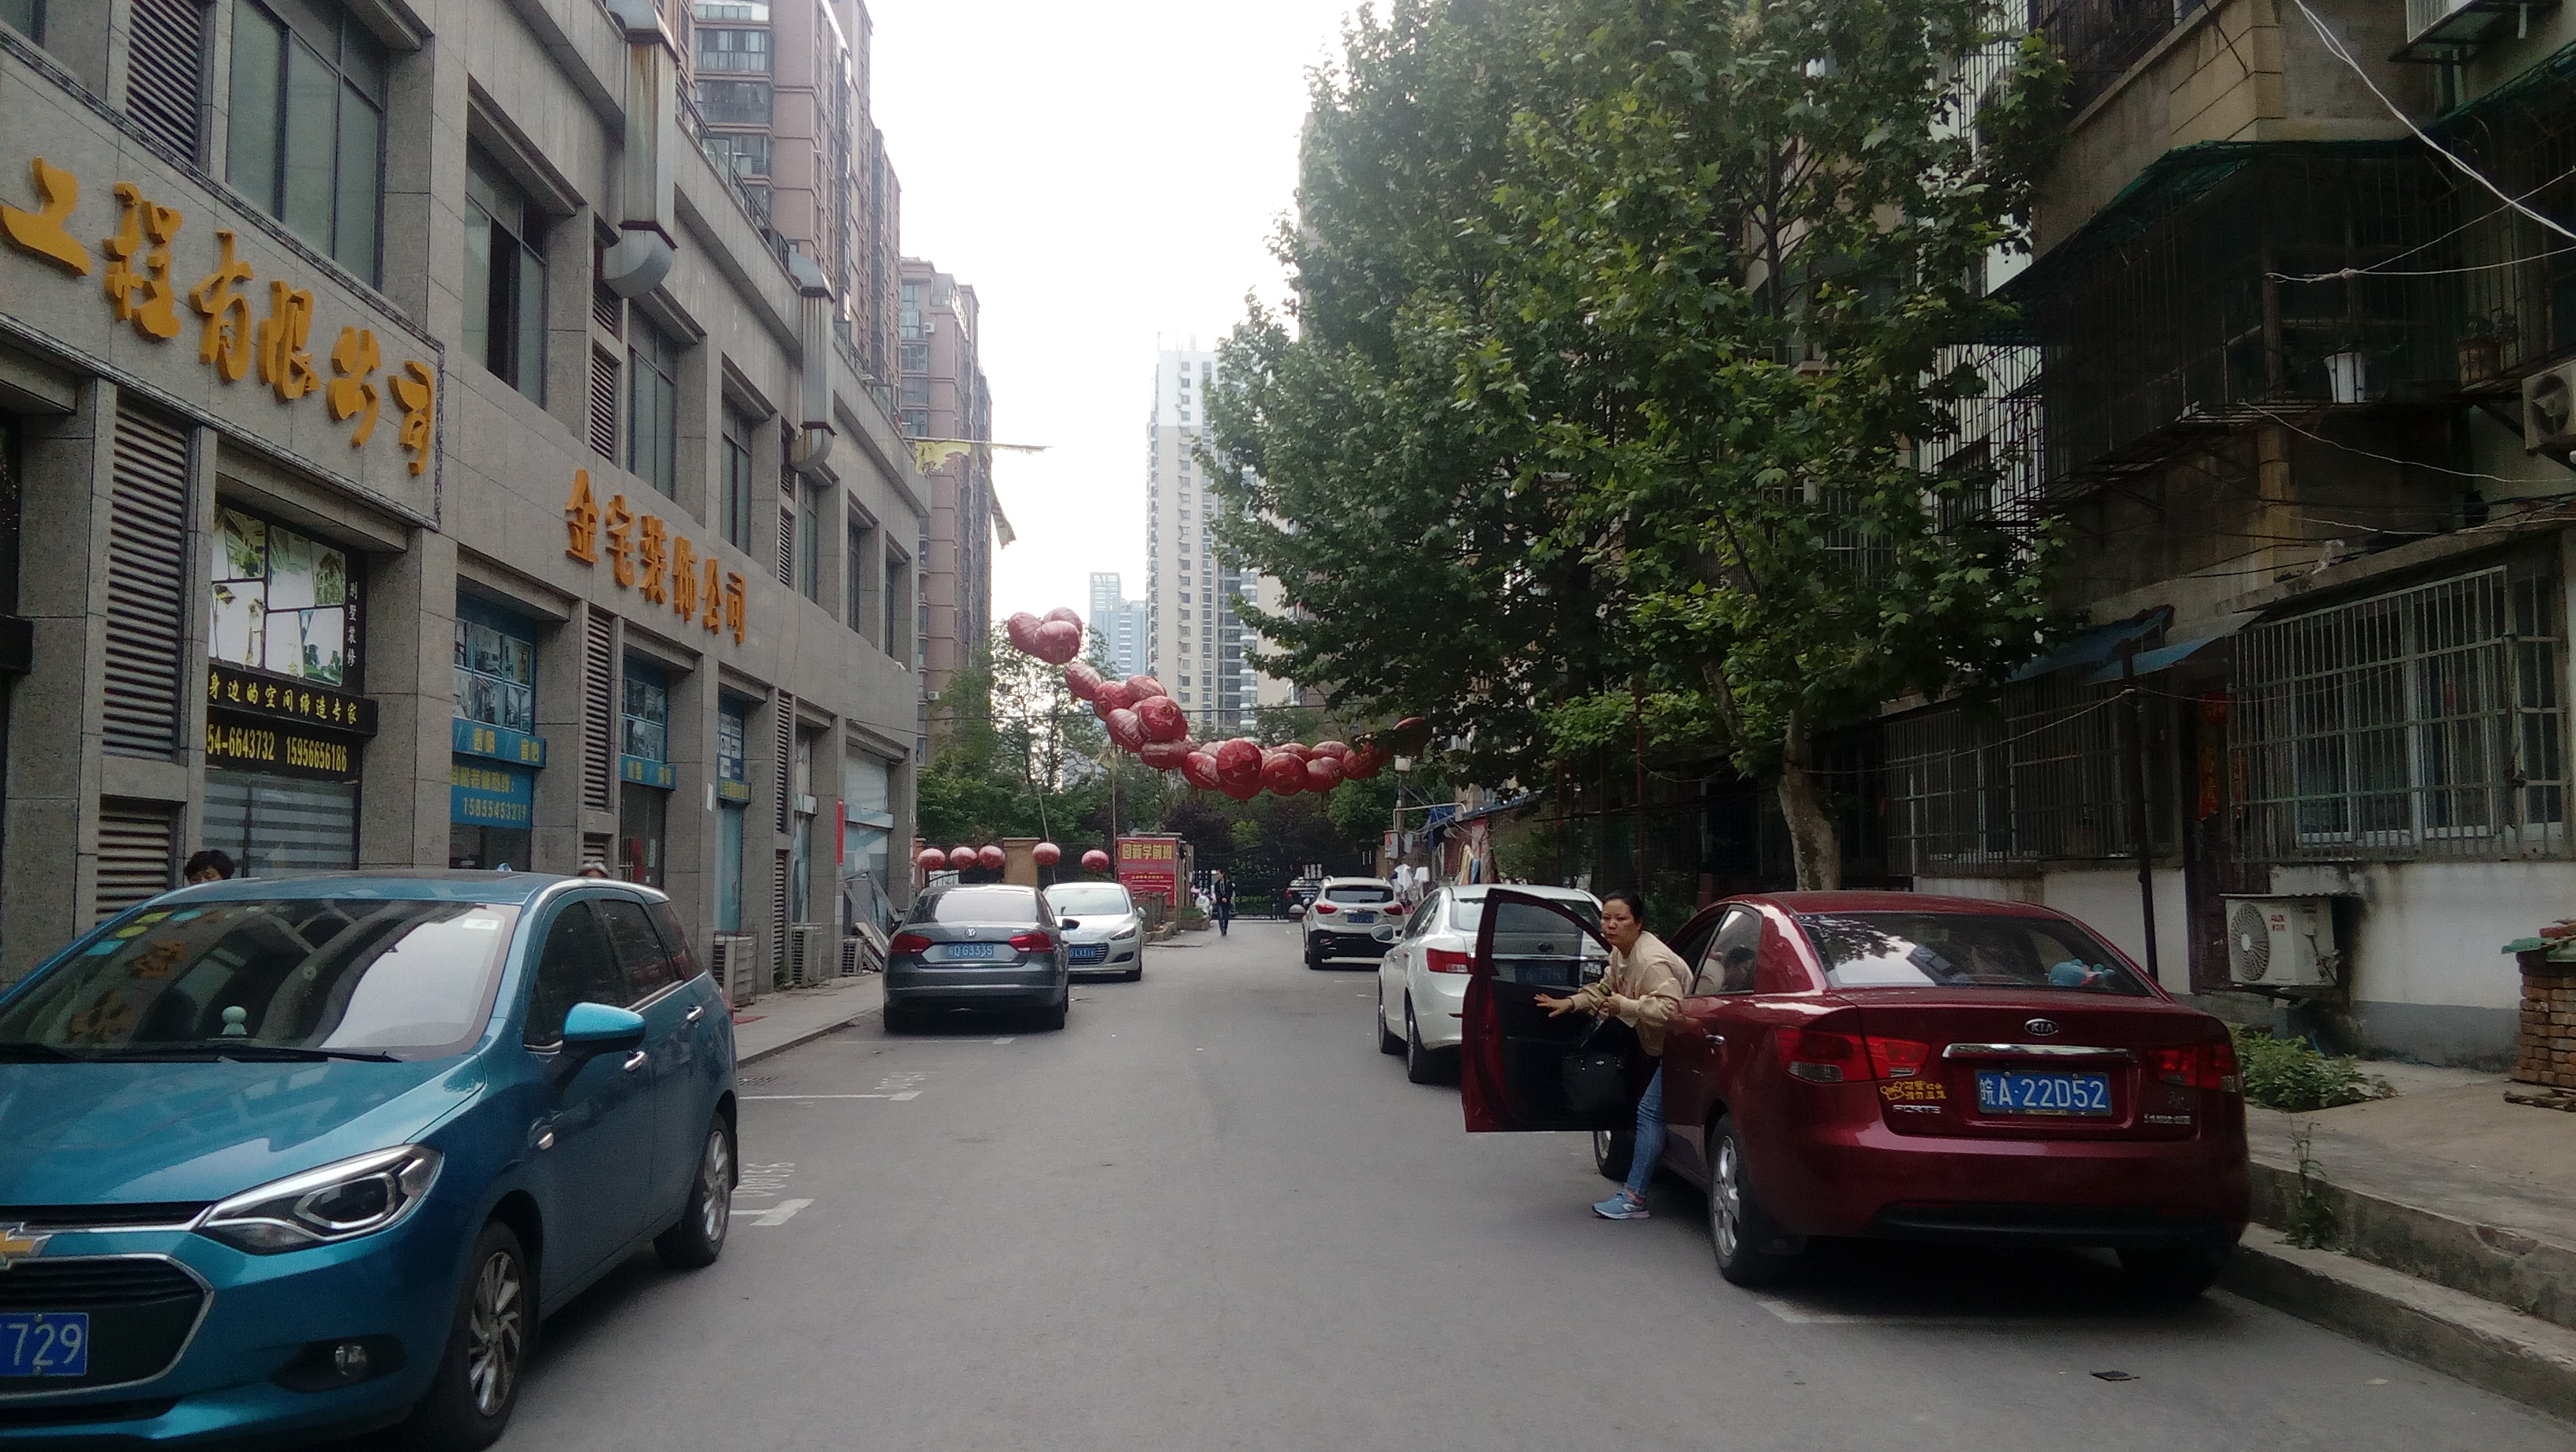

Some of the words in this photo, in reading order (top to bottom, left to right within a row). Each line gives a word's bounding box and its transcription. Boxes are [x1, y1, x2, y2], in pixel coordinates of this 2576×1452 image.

[0, 157, 435, 477] 工程有限公司
[566, 470, 746, 646] 金宅装饰公司
[2031, 1023, 2054, 1032] KIA
